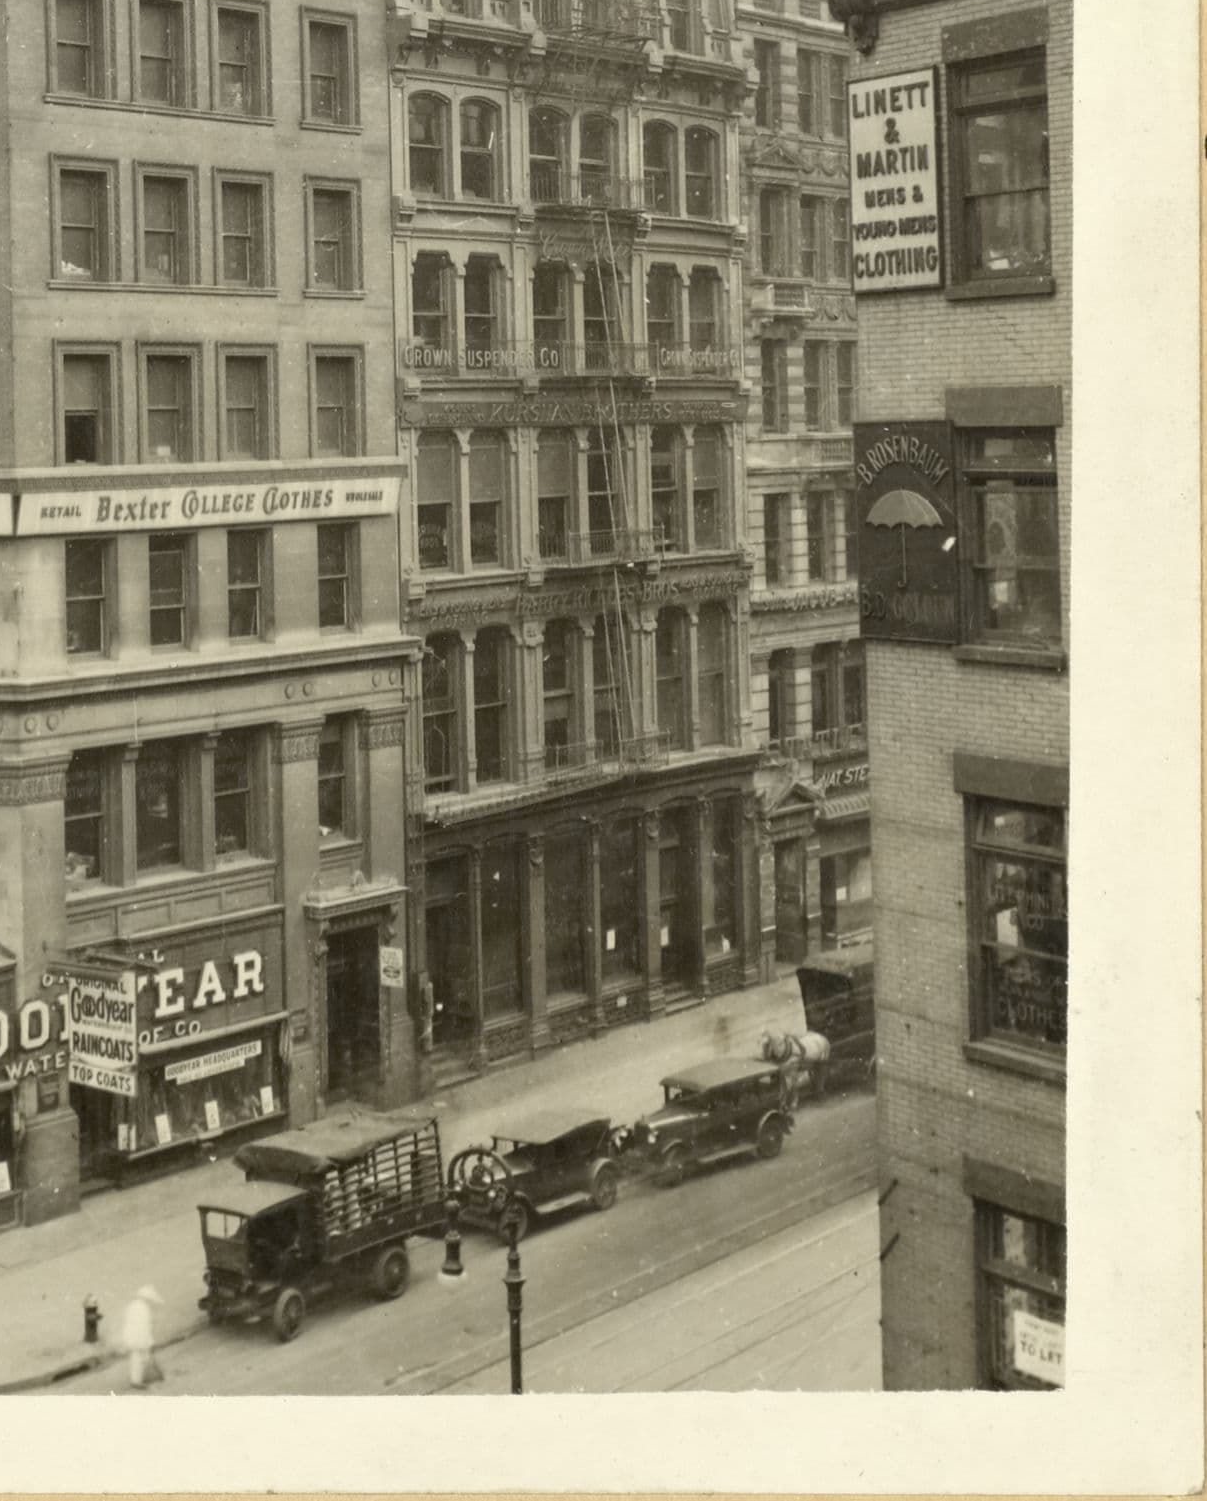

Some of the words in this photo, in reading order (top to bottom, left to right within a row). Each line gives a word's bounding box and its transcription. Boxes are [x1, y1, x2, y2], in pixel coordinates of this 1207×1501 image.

[852, 81, 930, 119] LINETT
[884, 117, 900, 144] &
[856, 145, 930, 179] MARTIN
[864, 187, 906, 209] MENS
[912, 185, 924, 203] &
[853, 219, 898, 242] YOUNG
[899, 214, 937, 237] MENS
[854, 245, 938, 279] CLOTHING
[405, 346, 452, 367] CROWN
[580, 401, 674, 422] BROTHERS
[857, 463, 874, 486] B.
[866, 435, 950, 485] ROSENBAUM
[40, 505, 82, 520] RETAIL
[70, 986, 134, 1024] Goodyear
[72, 1030, 134, 1063] RAINCOATS
[202, 1042, 258, 1066] HEADQUARTERS
[72, 1064, 93, 1082] TOP
[96, 1070, 132, 1093] COATS
[1020, 1341, 1036, 1357] TO
[1039, 1351, 1063, 1367] LET
